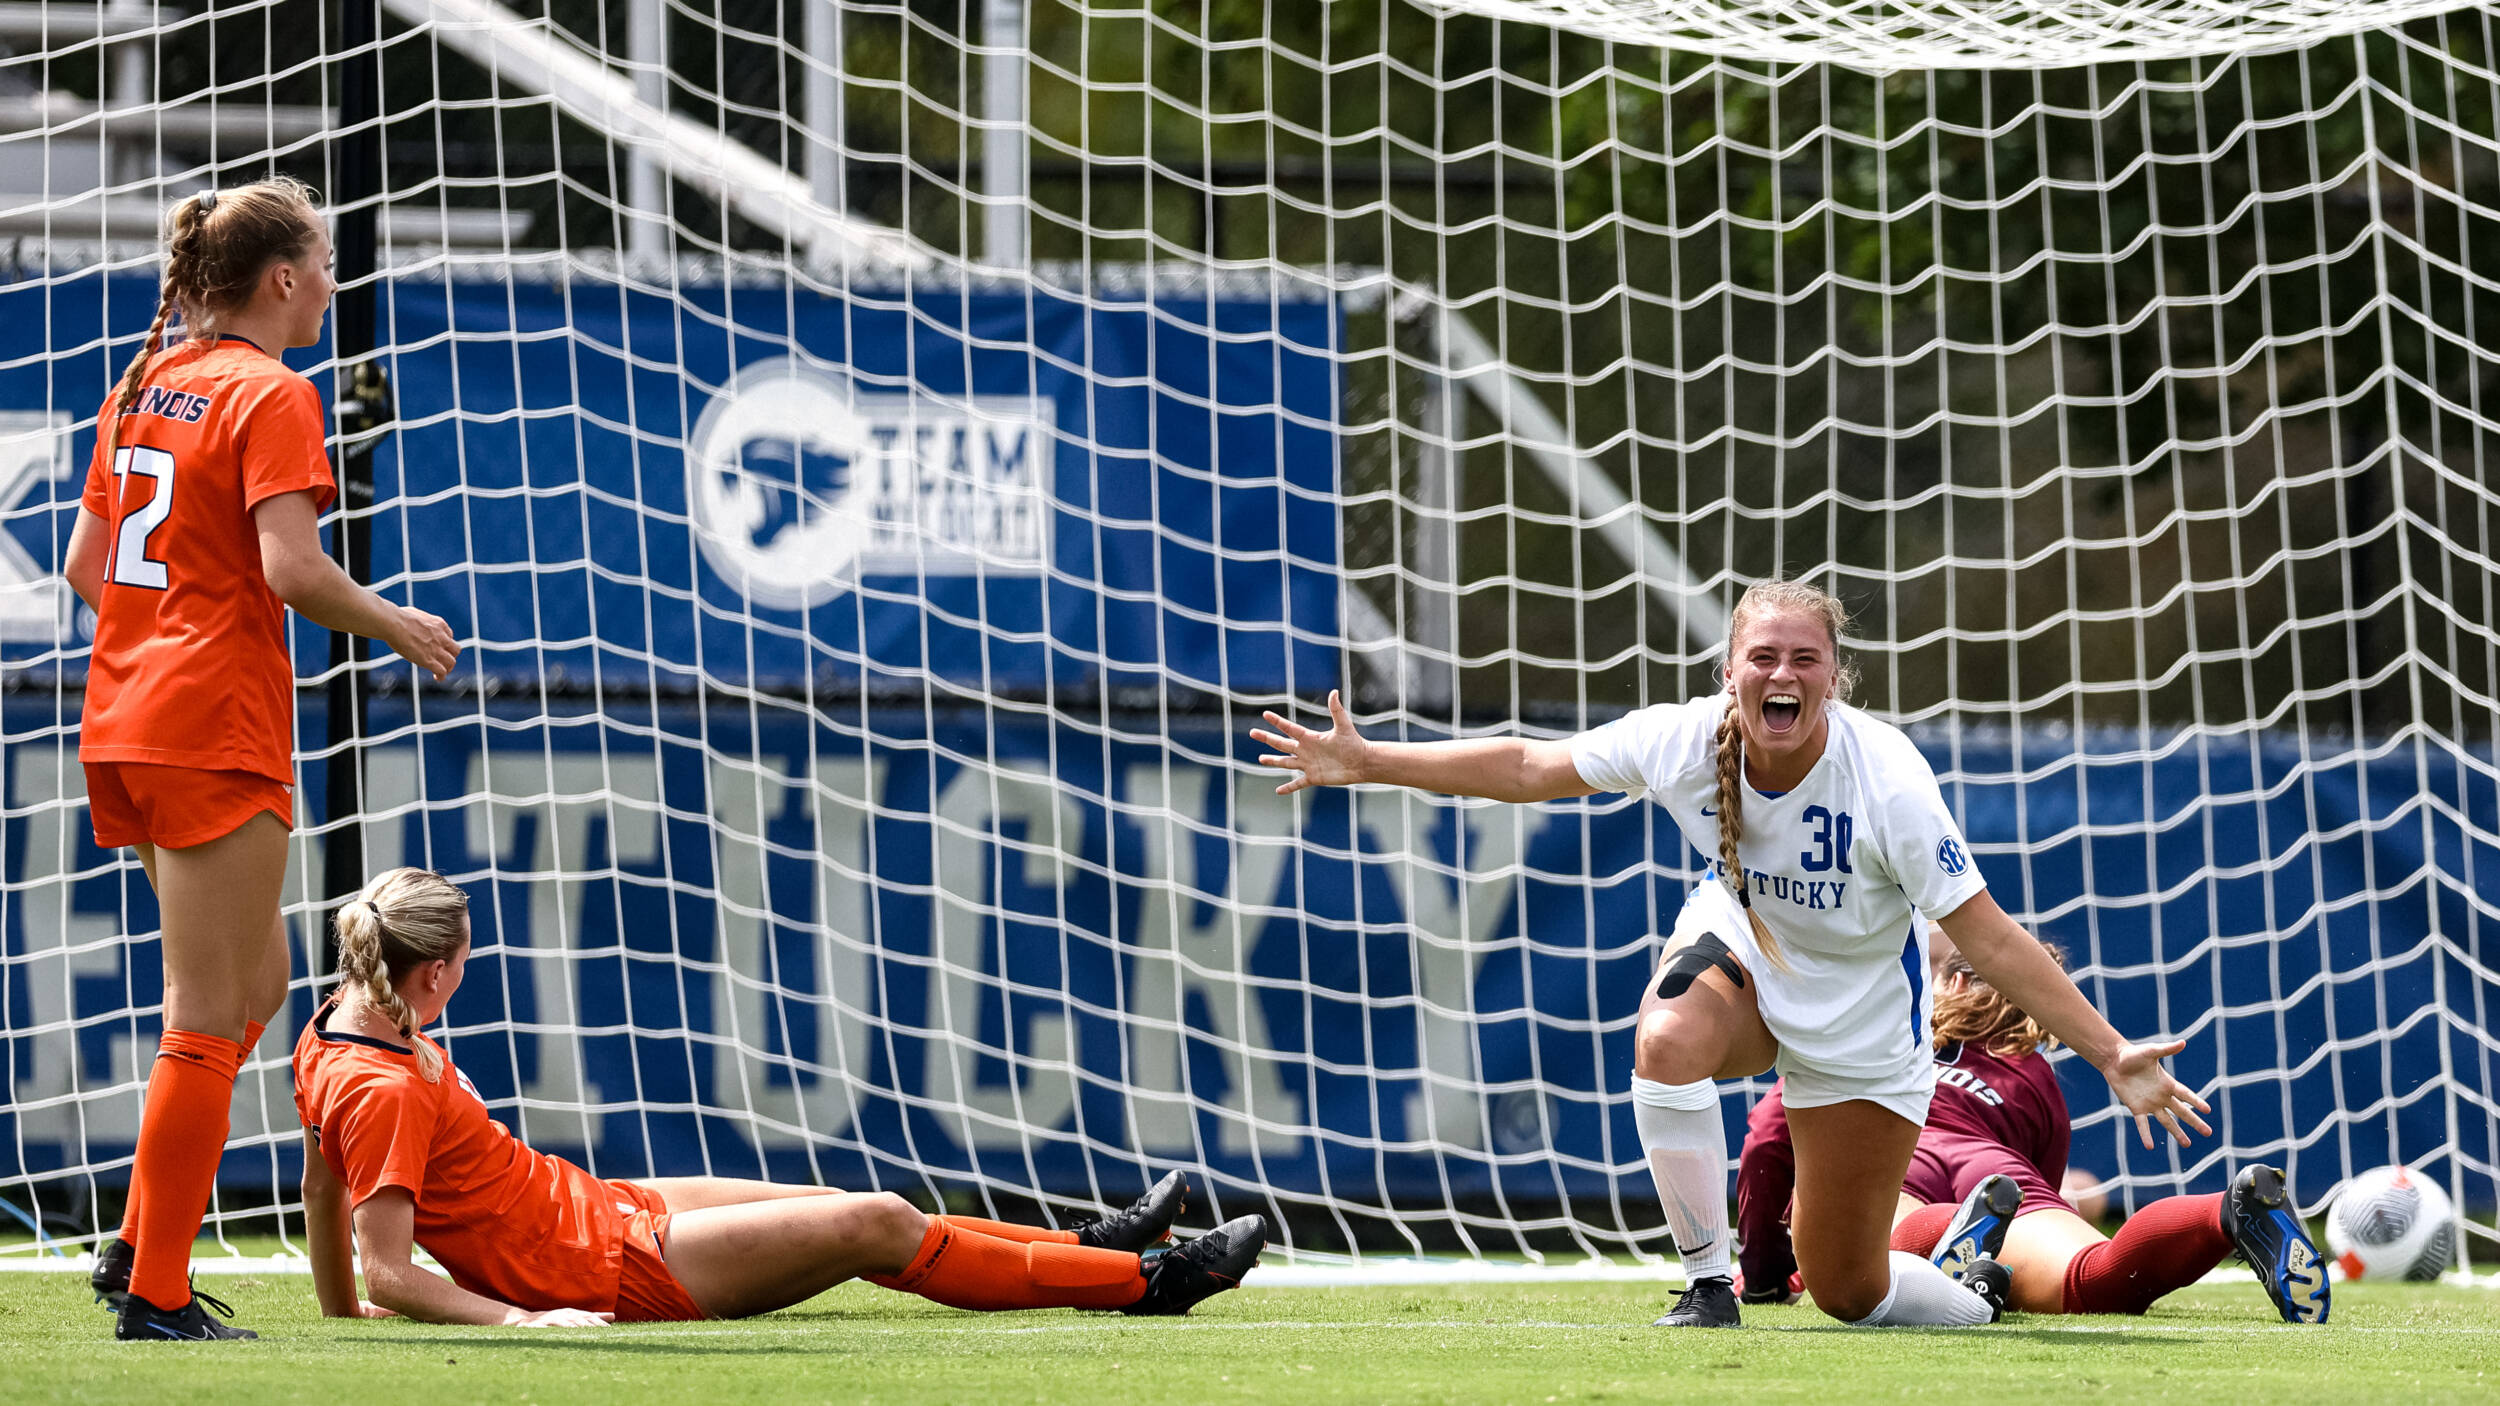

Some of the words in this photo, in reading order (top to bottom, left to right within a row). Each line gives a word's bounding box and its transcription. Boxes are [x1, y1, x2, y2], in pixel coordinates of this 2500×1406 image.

[869, 428, 1030, 496] TEAM
[1800, 804, 1854, 875] 30
[1939, 838, 1966, 873] SEC
